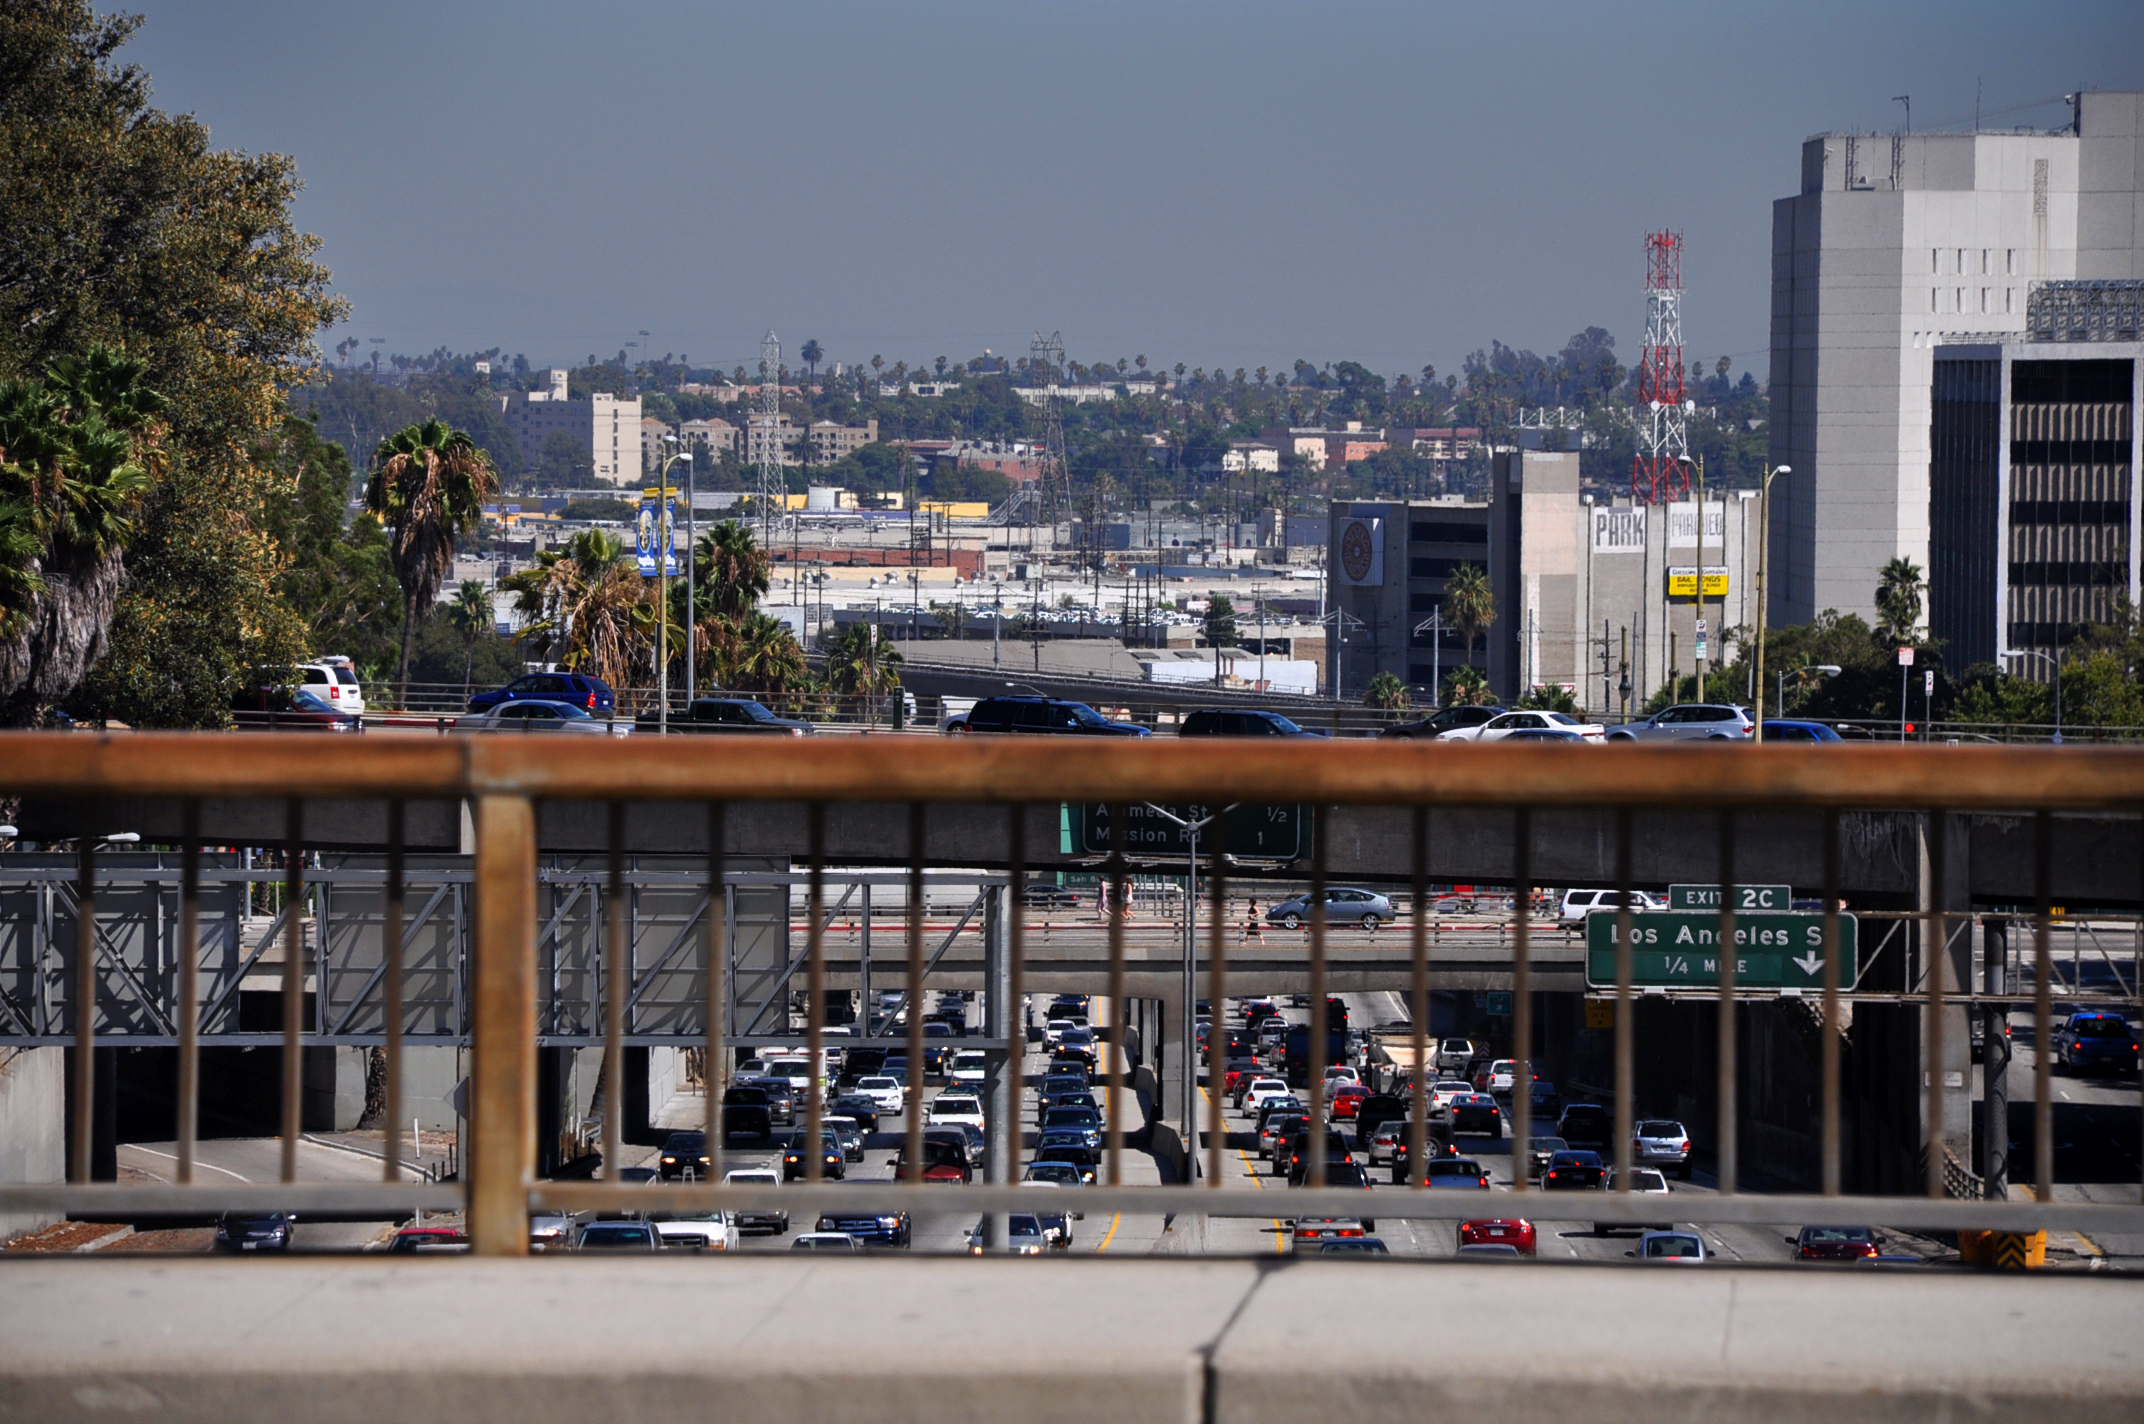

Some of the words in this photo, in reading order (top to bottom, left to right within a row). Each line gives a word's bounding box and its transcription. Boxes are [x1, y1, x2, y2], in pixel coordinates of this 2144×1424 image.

[1596, 513, 1644, 546] PARK
[1096, 803, 1177, 819] Ameda
[1188, 804, 1209, 819] St
[1096, 826, 1167, 843] Mssion
[1180, 828, 1202, 843] Rd
[1686, 890, 1723, 905] EXIT
[1742, 889, 1774, 908] 2C
[1611, 924, 1658, 945] Los
[1704, 959, 1748, 974] MIE
